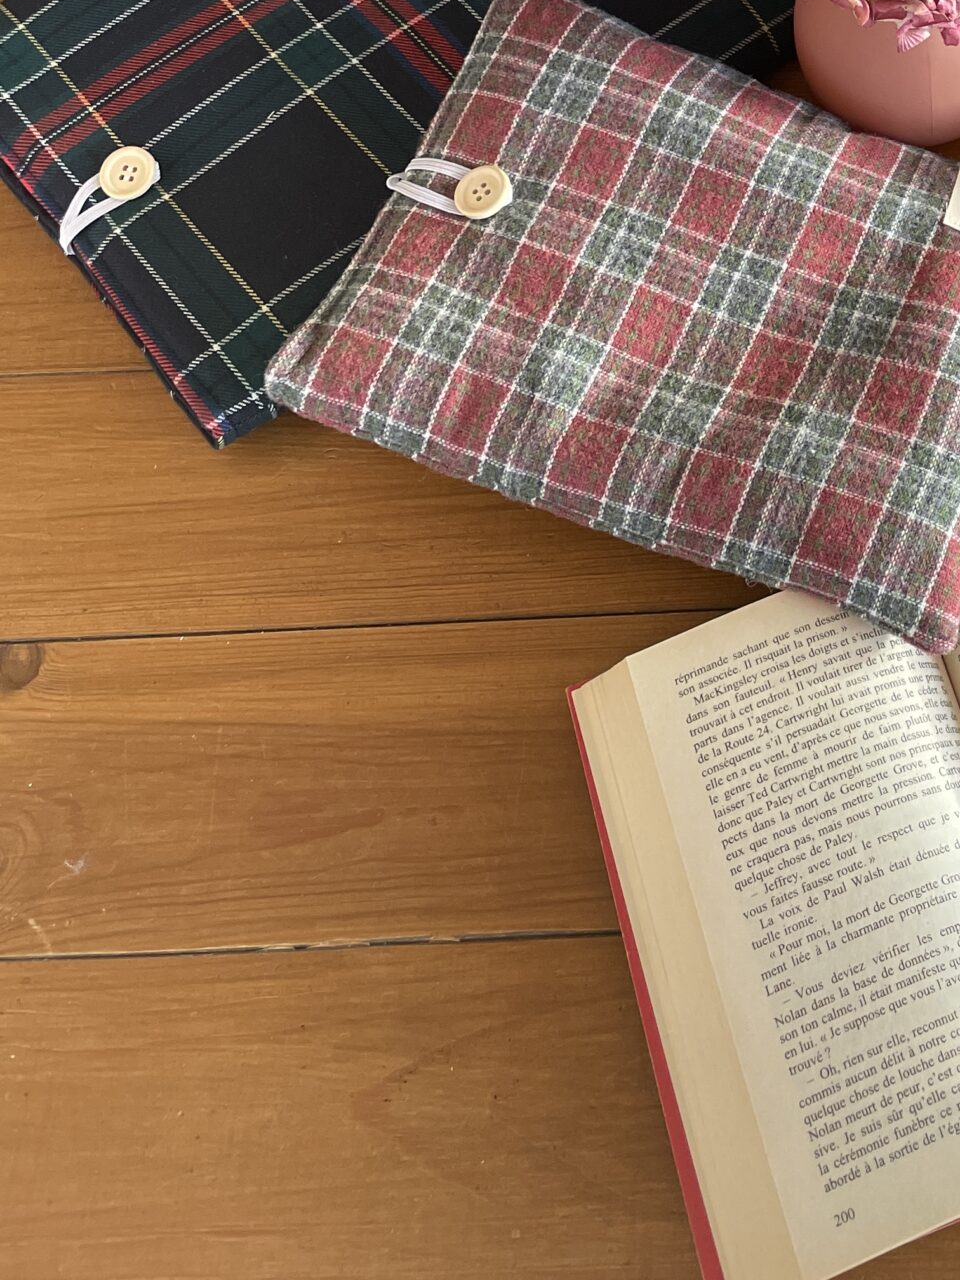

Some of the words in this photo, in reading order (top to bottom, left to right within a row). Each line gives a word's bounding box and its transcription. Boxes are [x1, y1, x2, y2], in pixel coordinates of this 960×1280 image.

[824, 1166, 861, 1193] abordé
[865, 1161, 872, 1174] à
[874, 1157, 886, 1170] la
[889, 1142, 919, 1162] sortie
[922, 1132, 936, 1146] de
[834, 1207, 856, 1227] 200
